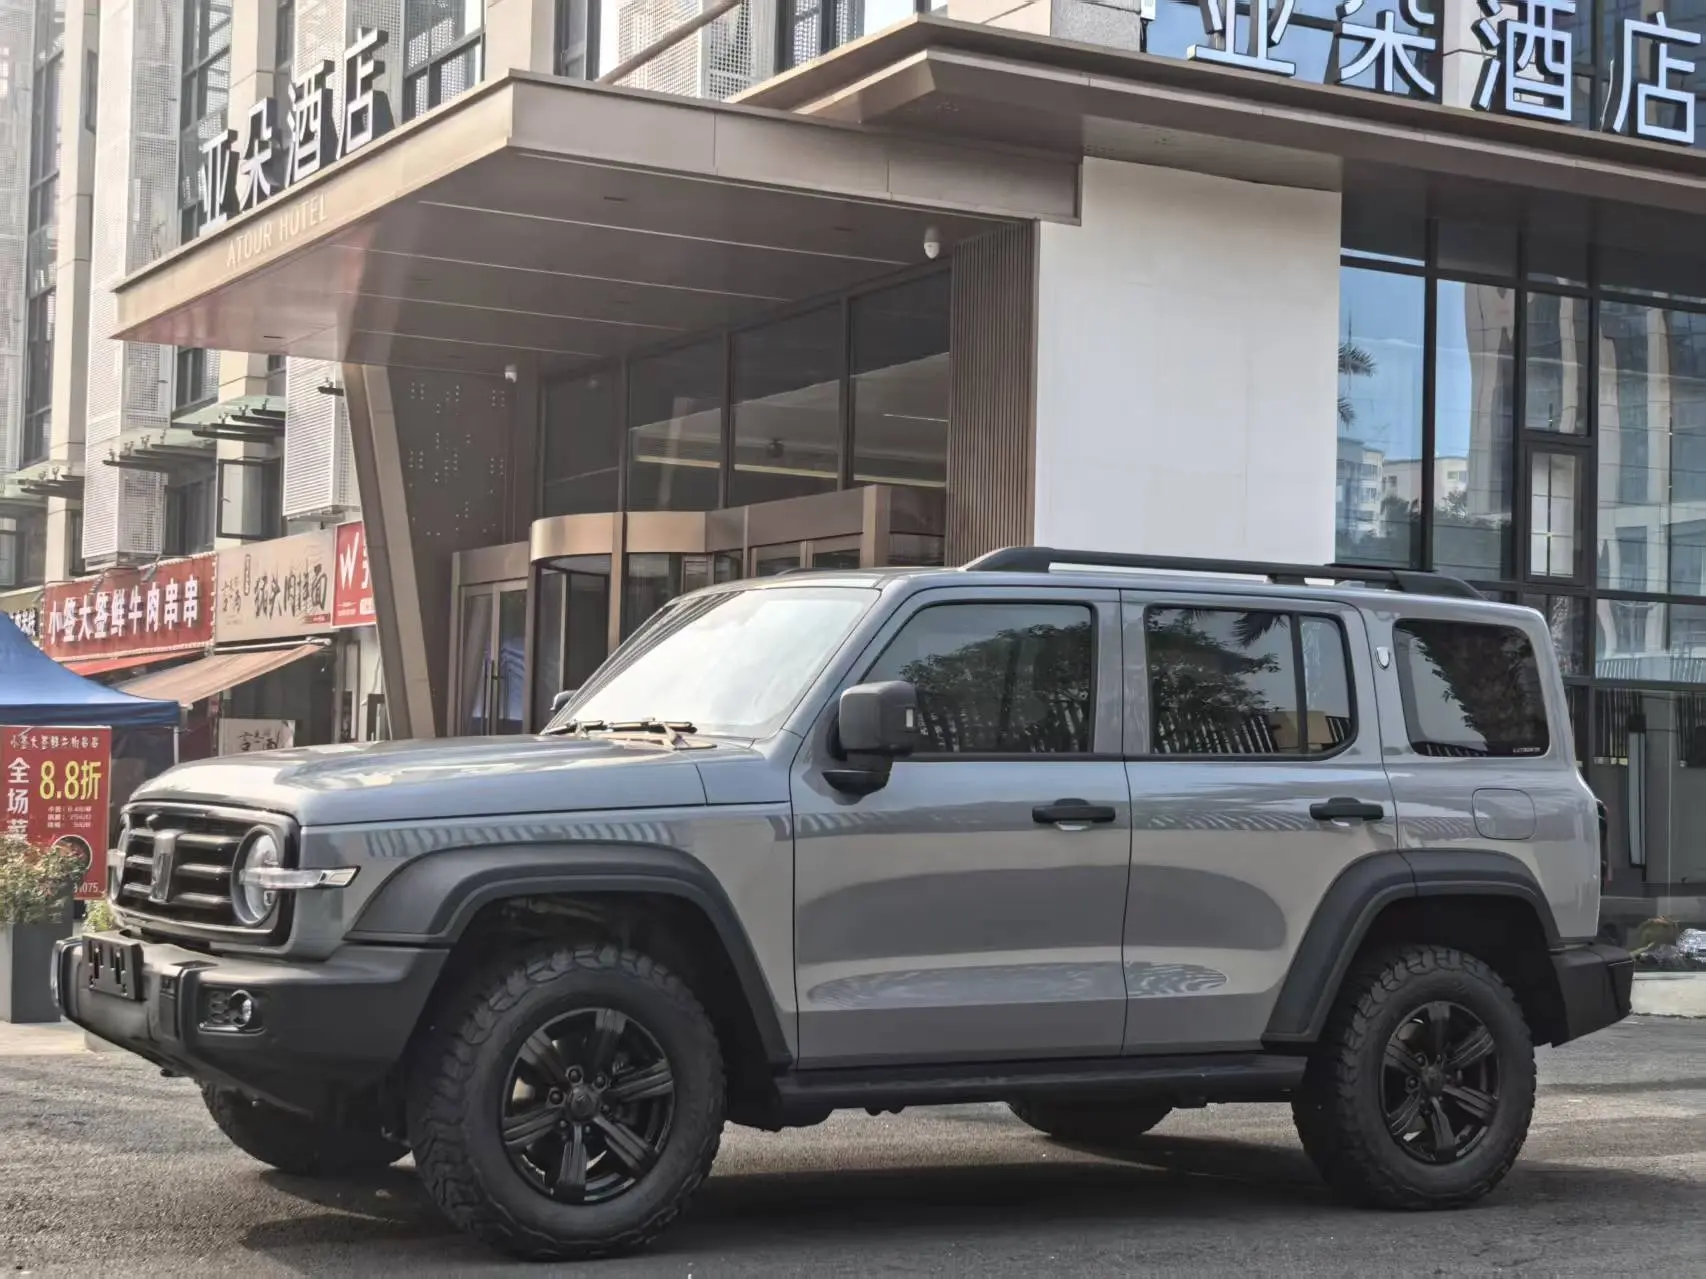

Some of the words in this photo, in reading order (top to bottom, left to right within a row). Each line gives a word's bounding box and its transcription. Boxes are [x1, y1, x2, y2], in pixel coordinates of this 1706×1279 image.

[198, 26, 388, 233] 亚朵酒店
[226, 221, 273, 268] ATOUR
[280, 191, 328, 241] HOTEL
[48, 575, 198, 645] 小签大签鲜牛肉串串
[39, 759, 102, 801] 8.8折
